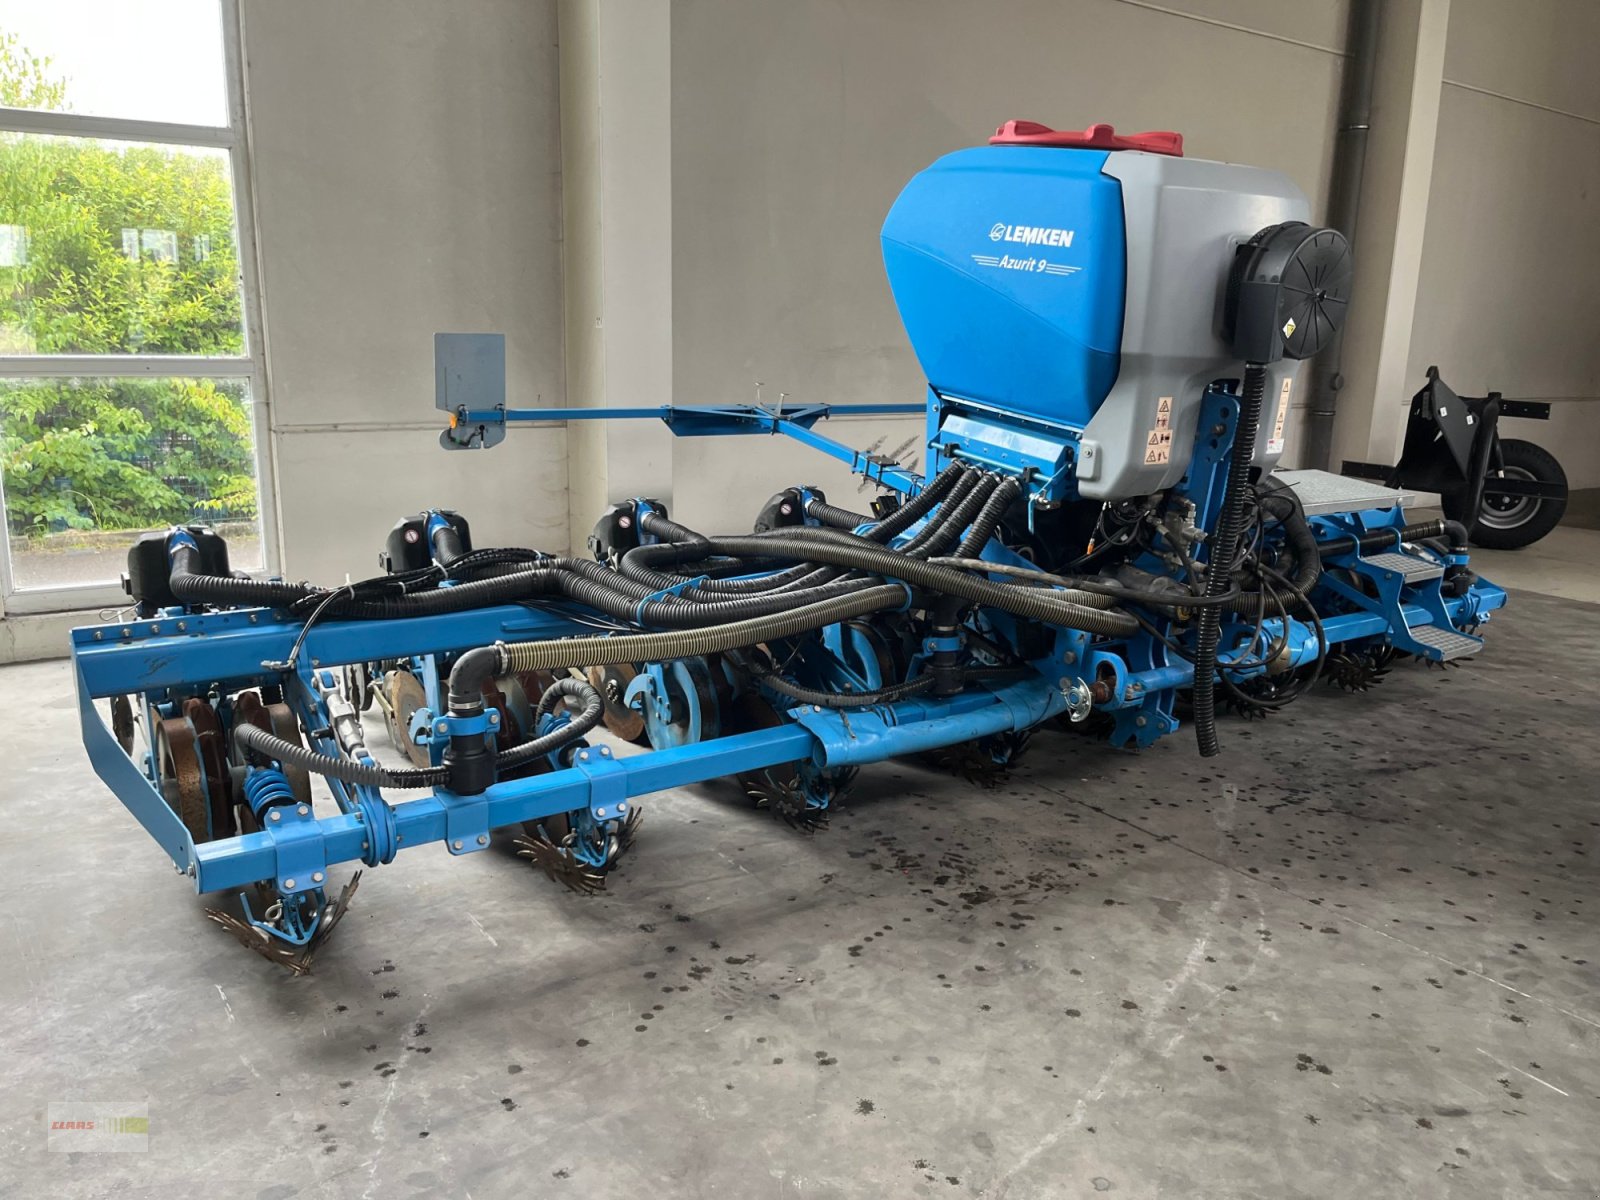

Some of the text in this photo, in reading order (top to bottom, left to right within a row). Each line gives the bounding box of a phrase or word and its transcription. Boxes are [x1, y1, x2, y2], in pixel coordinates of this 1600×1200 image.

[1004, 225, 1074, 247] LEMKEN
[999, 255, 1047, 273] Azurit 9
